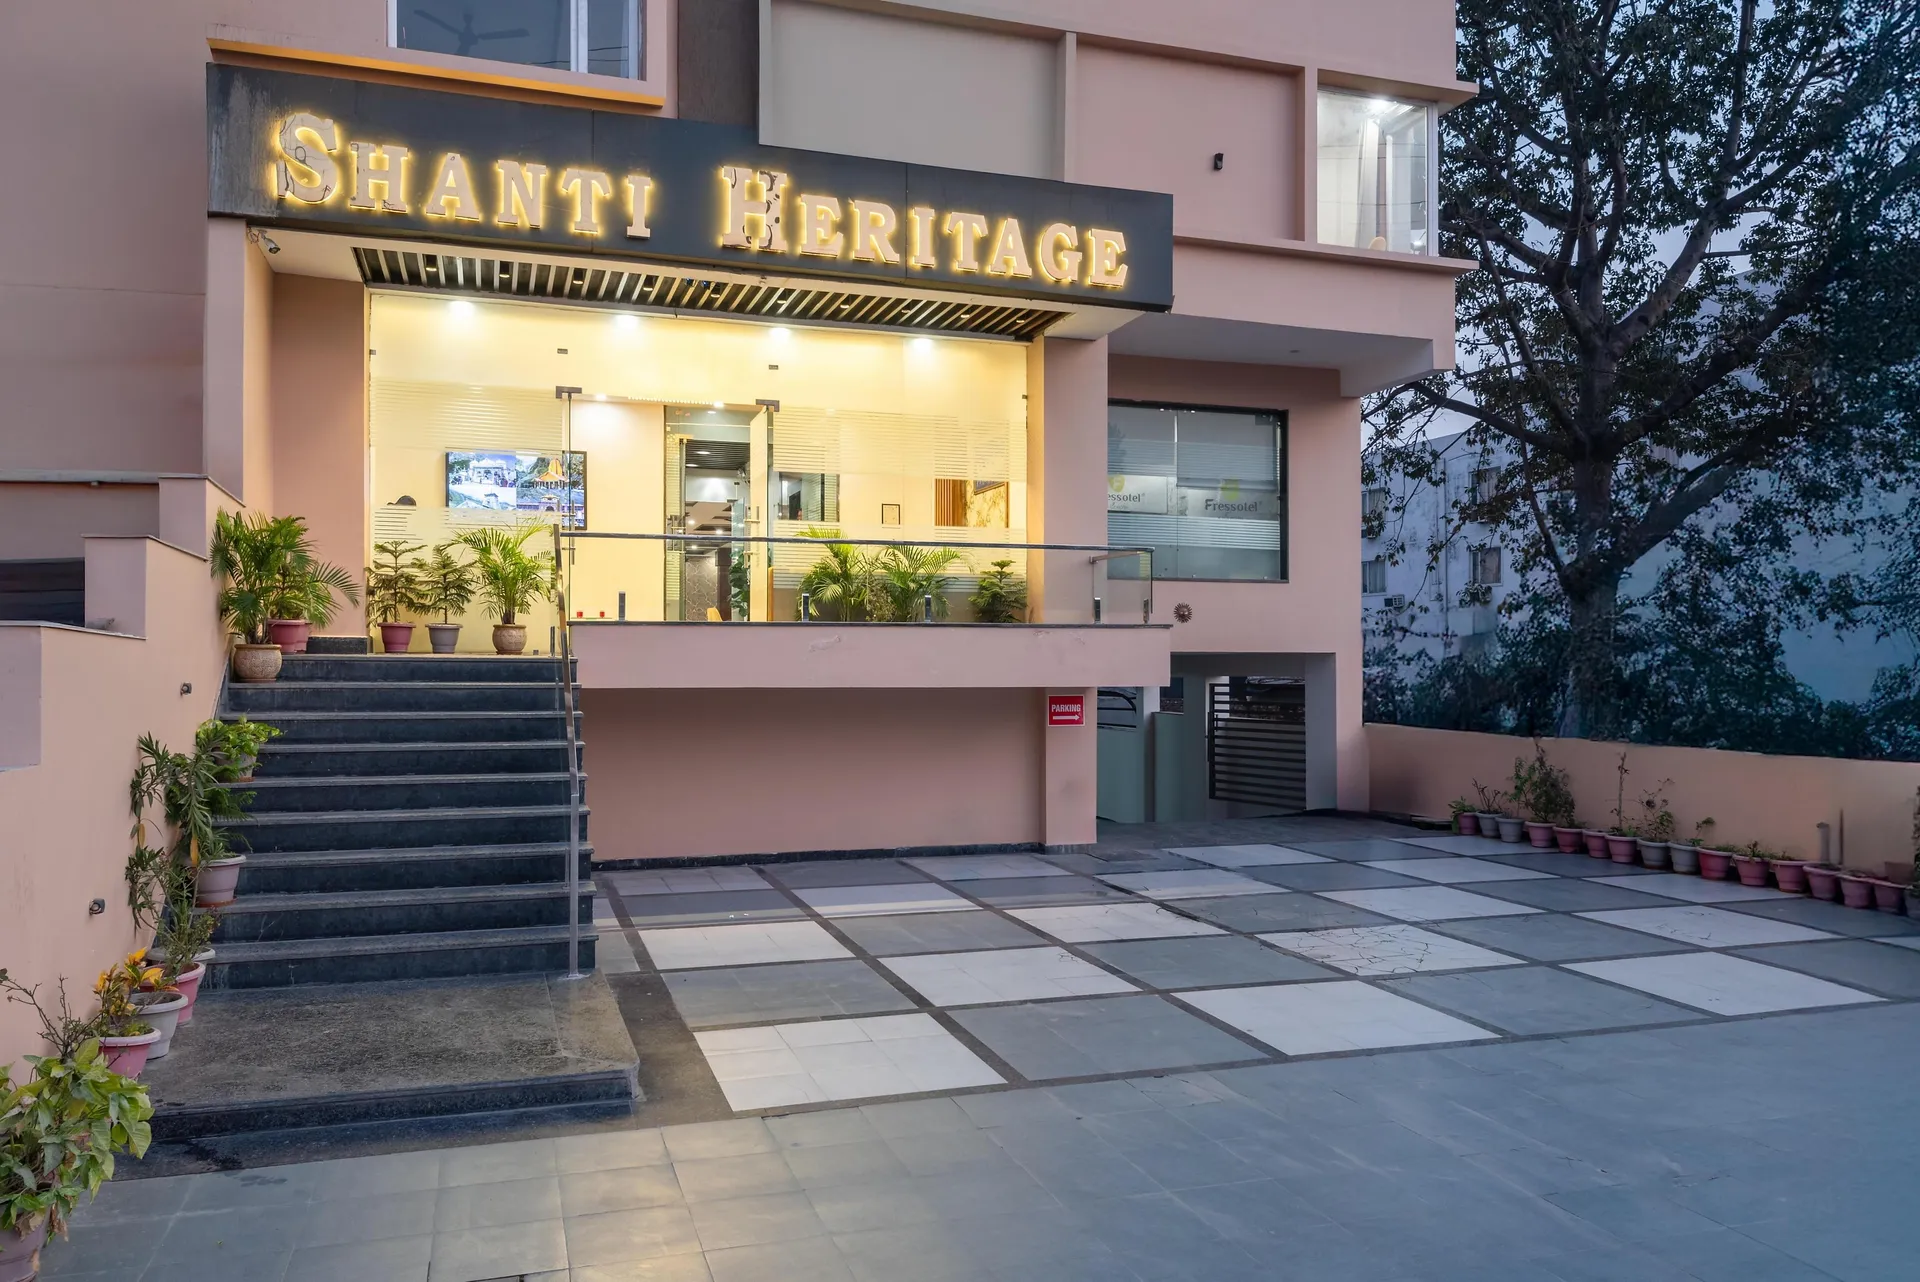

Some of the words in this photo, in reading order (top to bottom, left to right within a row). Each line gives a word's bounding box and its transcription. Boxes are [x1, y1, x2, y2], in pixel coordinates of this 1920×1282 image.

[276, 111, 652, 238] SHANTI
[721, 164, 1129, 288] HERITAGE
[1204, 498, 1258, 512] Fressotel
[1051, 703, 1081, 713] PARKING
